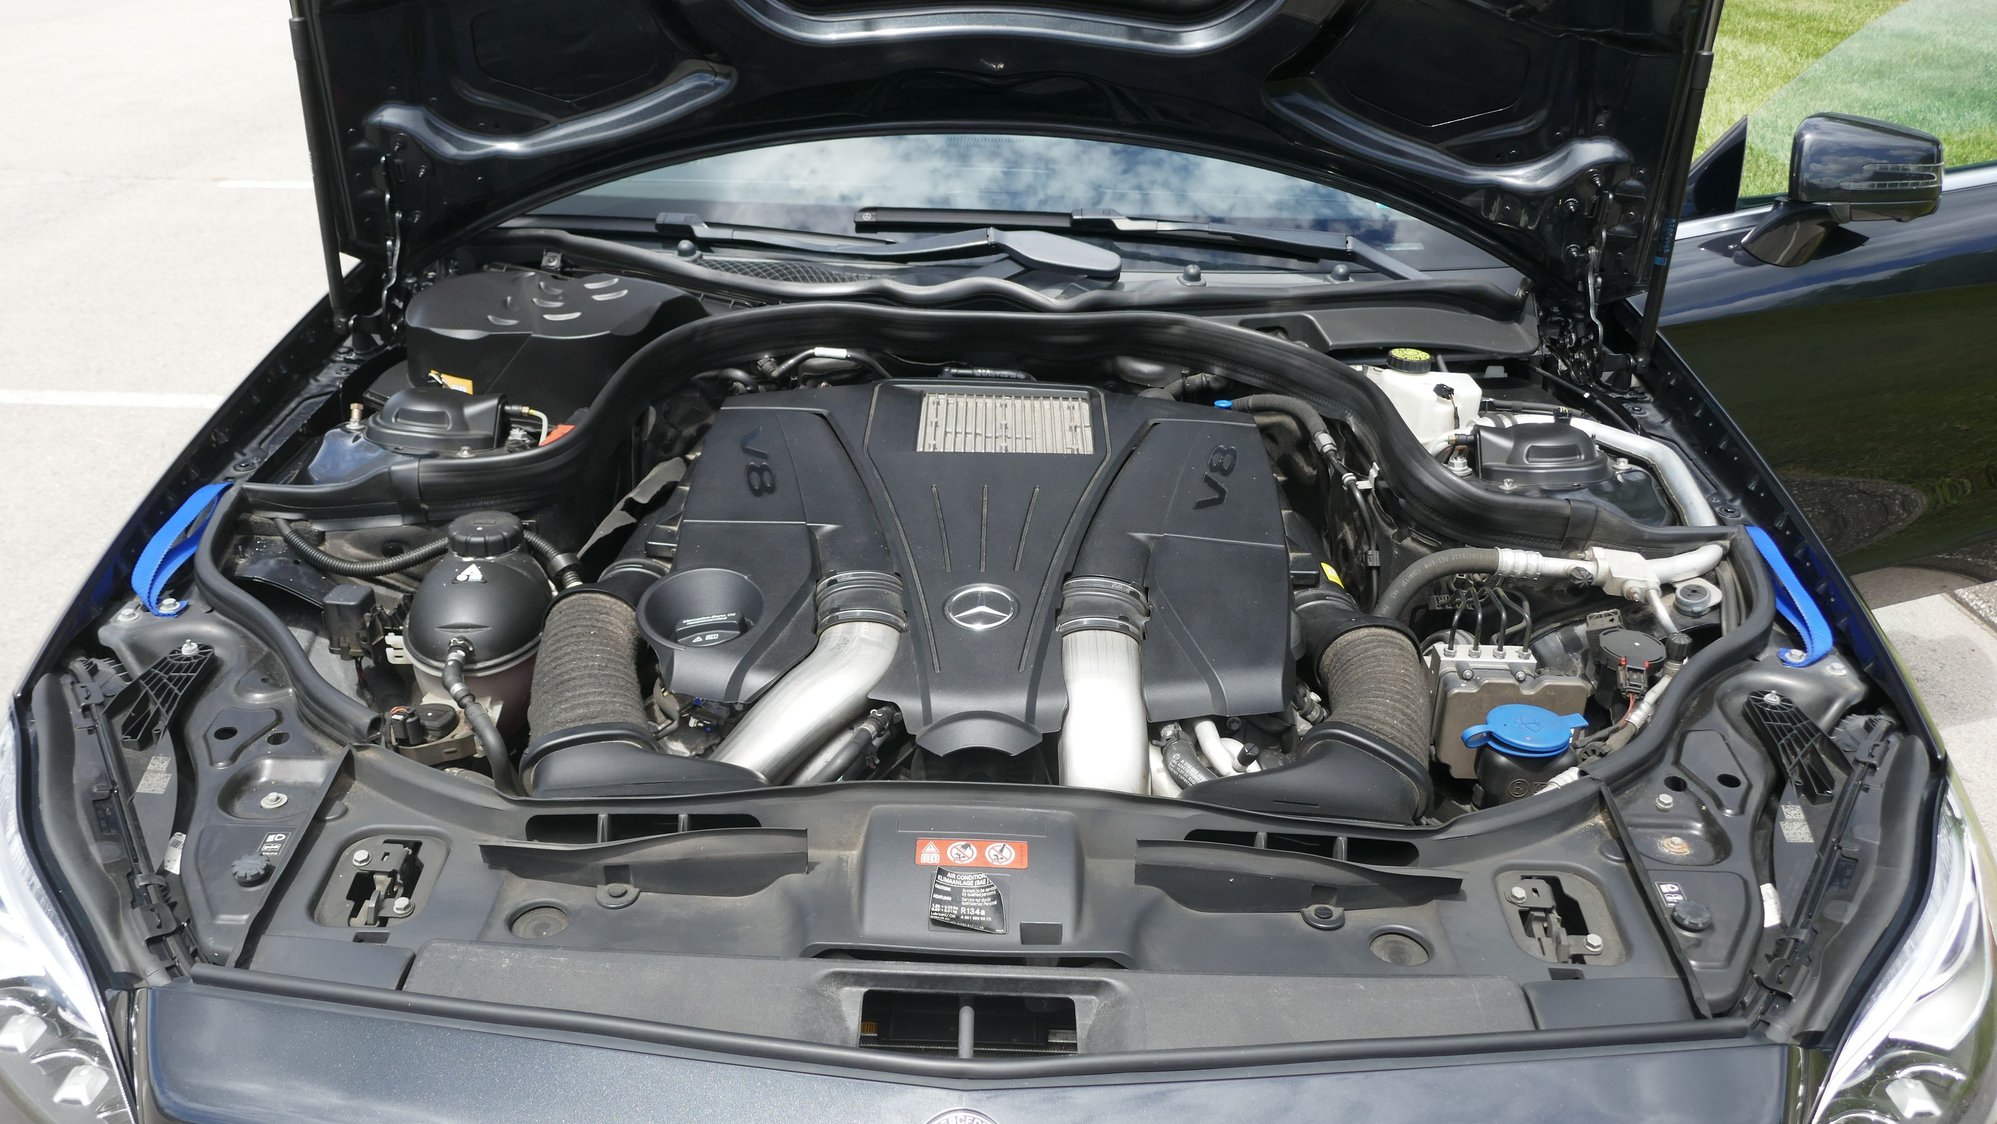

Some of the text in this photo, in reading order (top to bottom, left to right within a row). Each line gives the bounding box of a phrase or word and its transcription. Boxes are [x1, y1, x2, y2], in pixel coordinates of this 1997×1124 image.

[740, 427, 776, 497] V8
[1193, 445, 1238, 510] V8
[937, 875, 974, 886] KLIMAANLAGE
[960, 907, 985, 916] R134a
